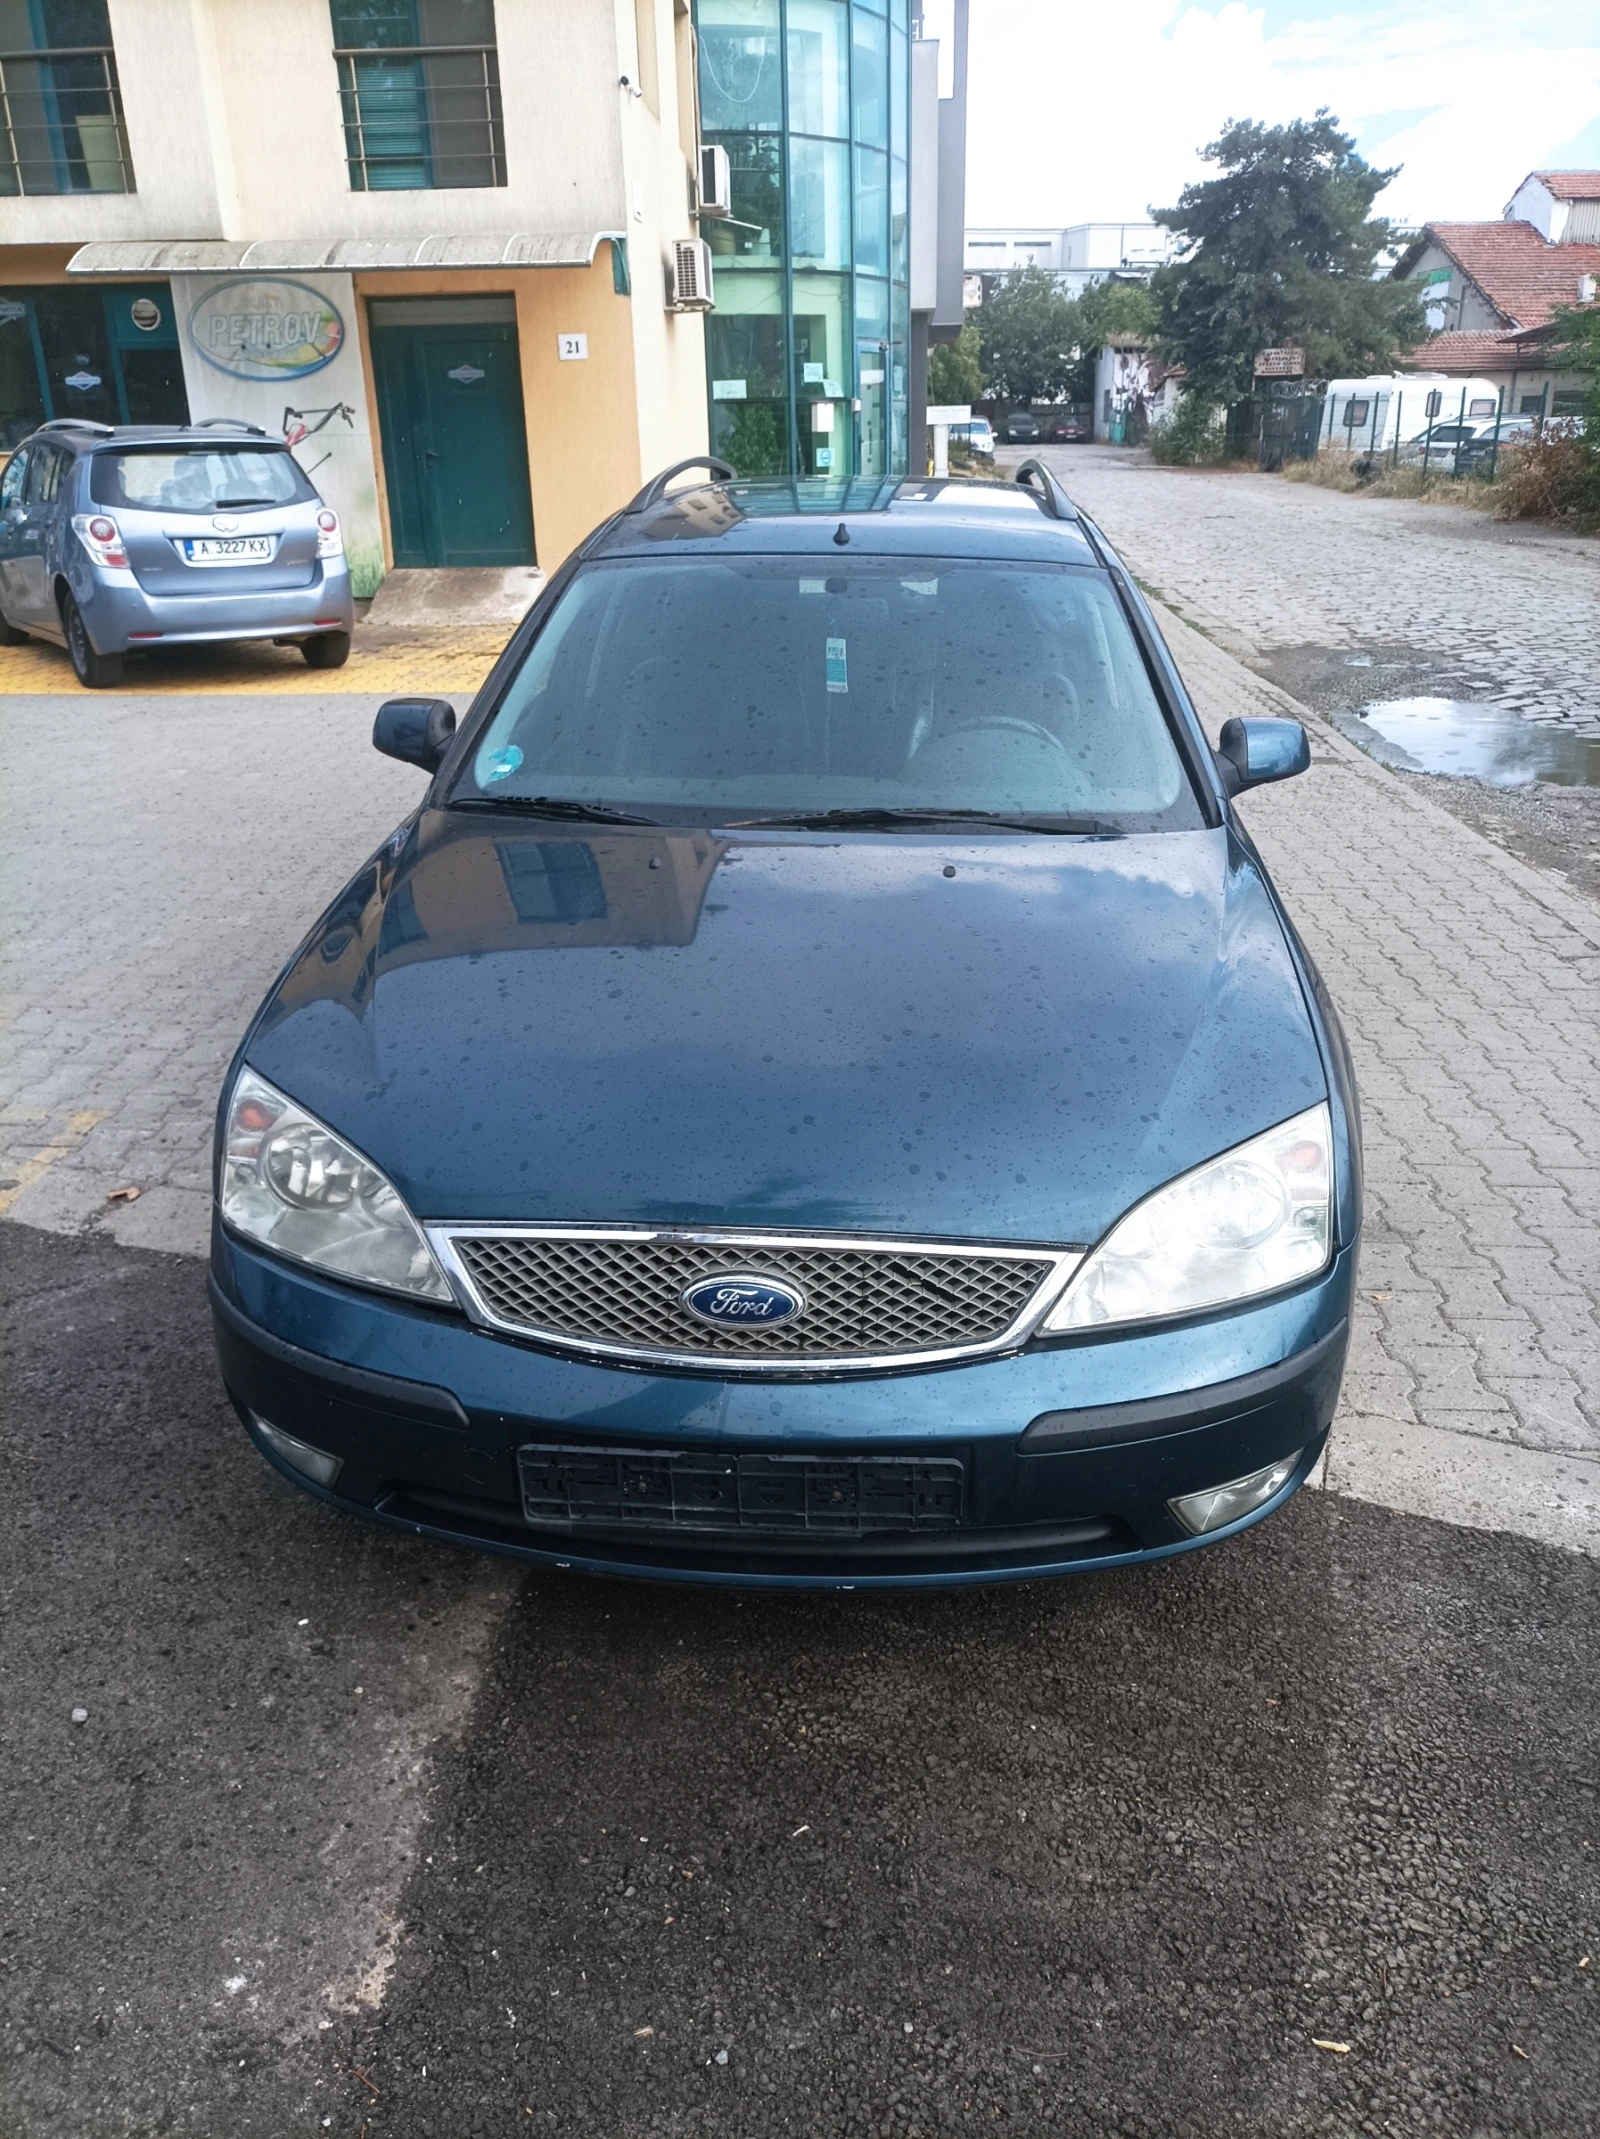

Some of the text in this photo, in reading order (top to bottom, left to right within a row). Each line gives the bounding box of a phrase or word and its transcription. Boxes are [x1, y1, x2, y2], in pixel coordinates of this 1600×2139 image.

[210, 312, 321, 347] PETROV
[566, 340, 580, 354] 21
[216, 540, 247, 554] 3227
[249, 539, 266, 553] KX
[709, 1288, 775, 1316] Ford
